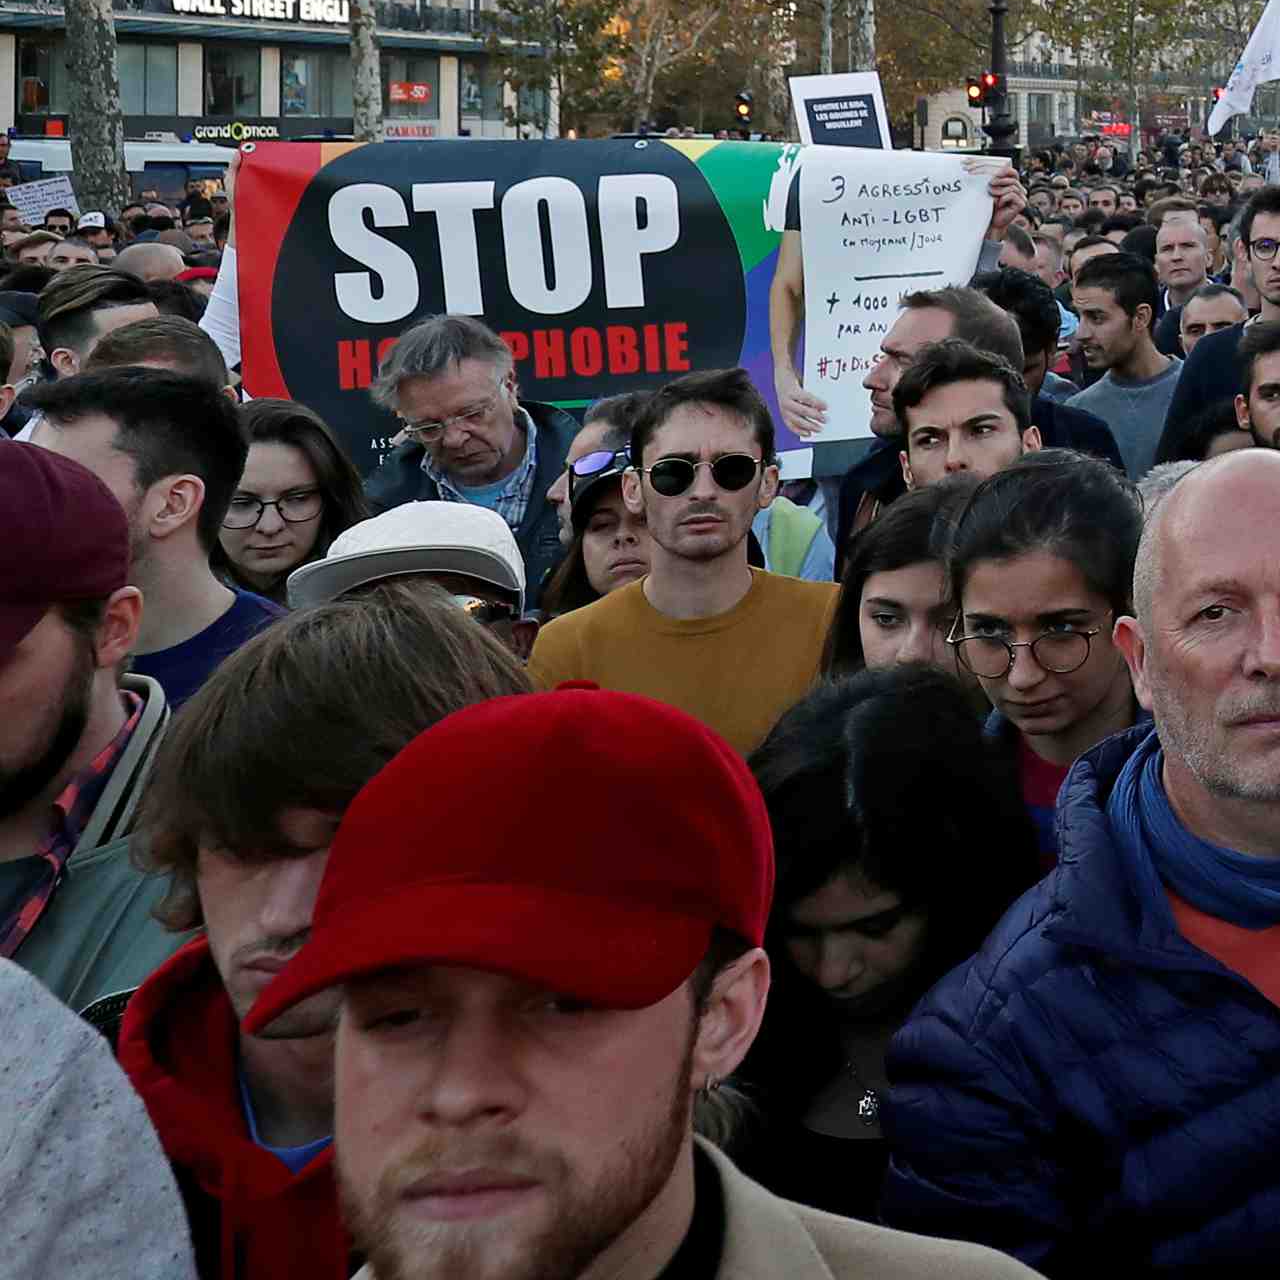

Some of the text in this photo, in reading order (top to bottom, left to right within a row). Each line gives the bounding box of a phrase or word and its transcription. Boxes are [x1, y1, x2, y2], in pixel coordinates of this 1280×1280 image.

[822, 175, 846, 204] 3
[327, 173, 681, 324] STOP
[852, 293, 888, 311] 1000
[837, 323, 861, 339] PAR
